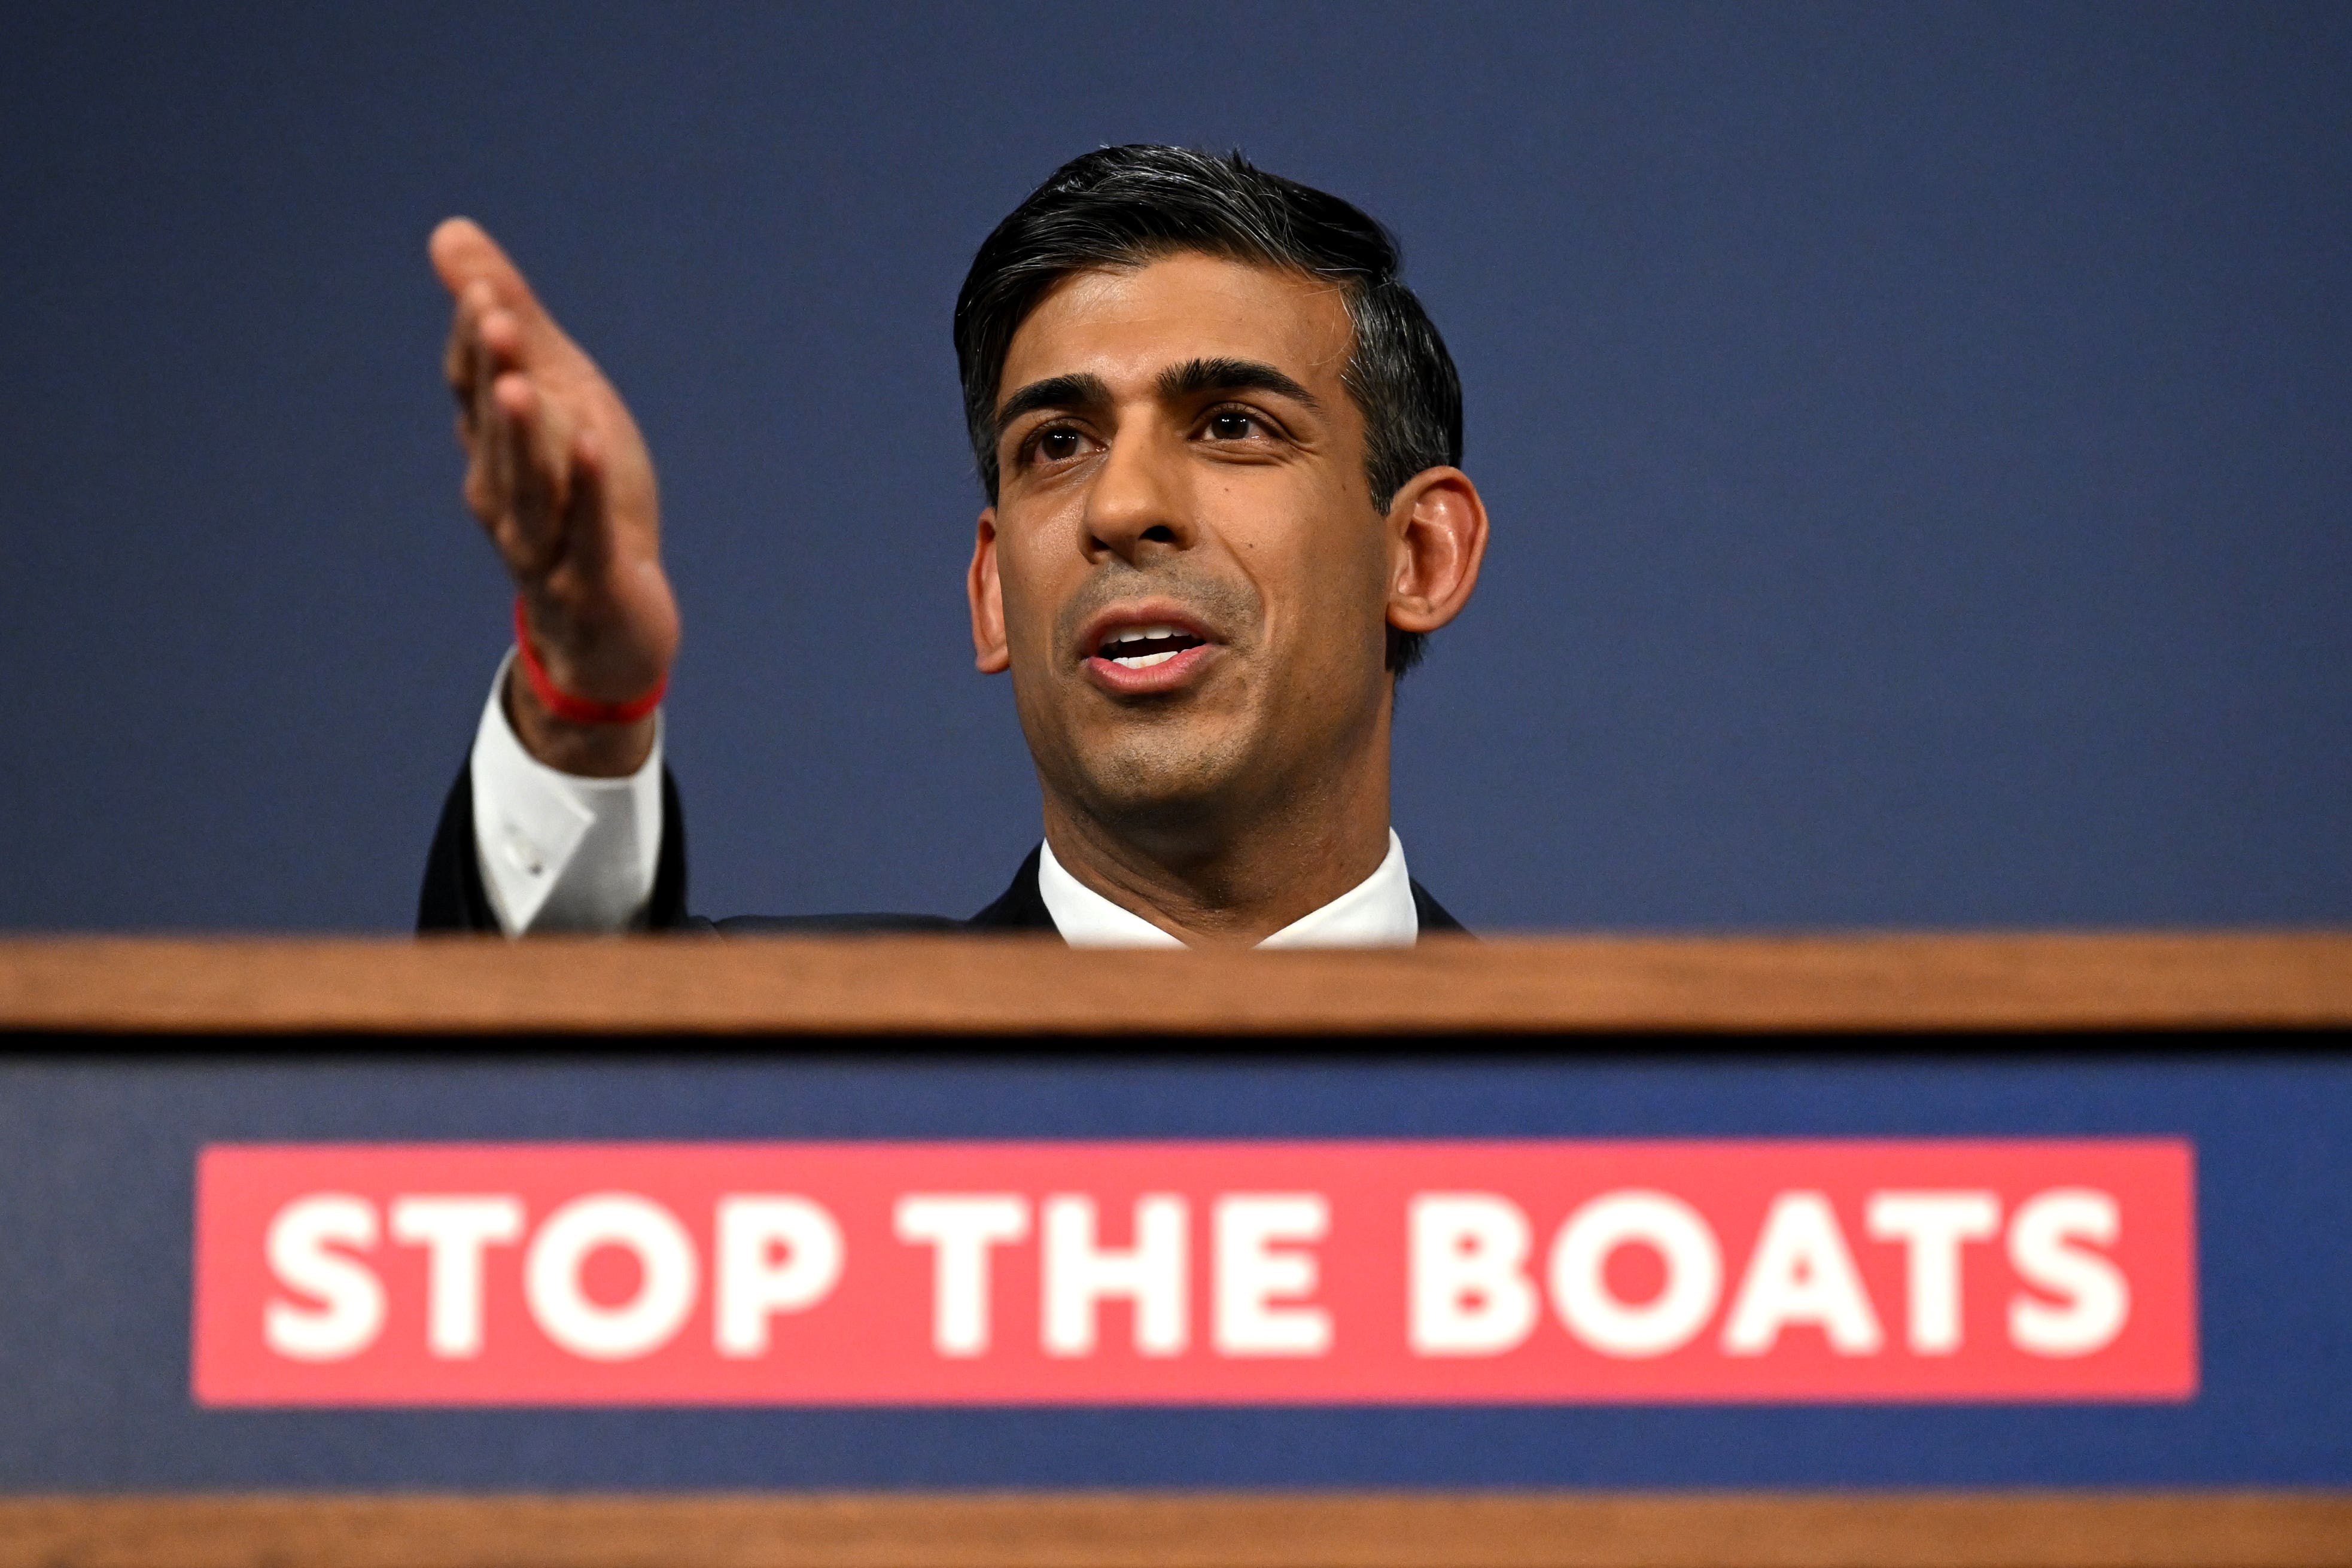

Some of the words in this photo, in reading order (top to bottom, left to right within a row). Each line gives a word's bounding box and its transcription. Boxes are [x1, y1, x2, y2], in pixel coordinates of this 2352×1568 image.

[264, 1192, 845, 1360] STOP
[894, 1193, 1332, 1357] THE
[1408, 1189, 2128, 1357] BOATS
